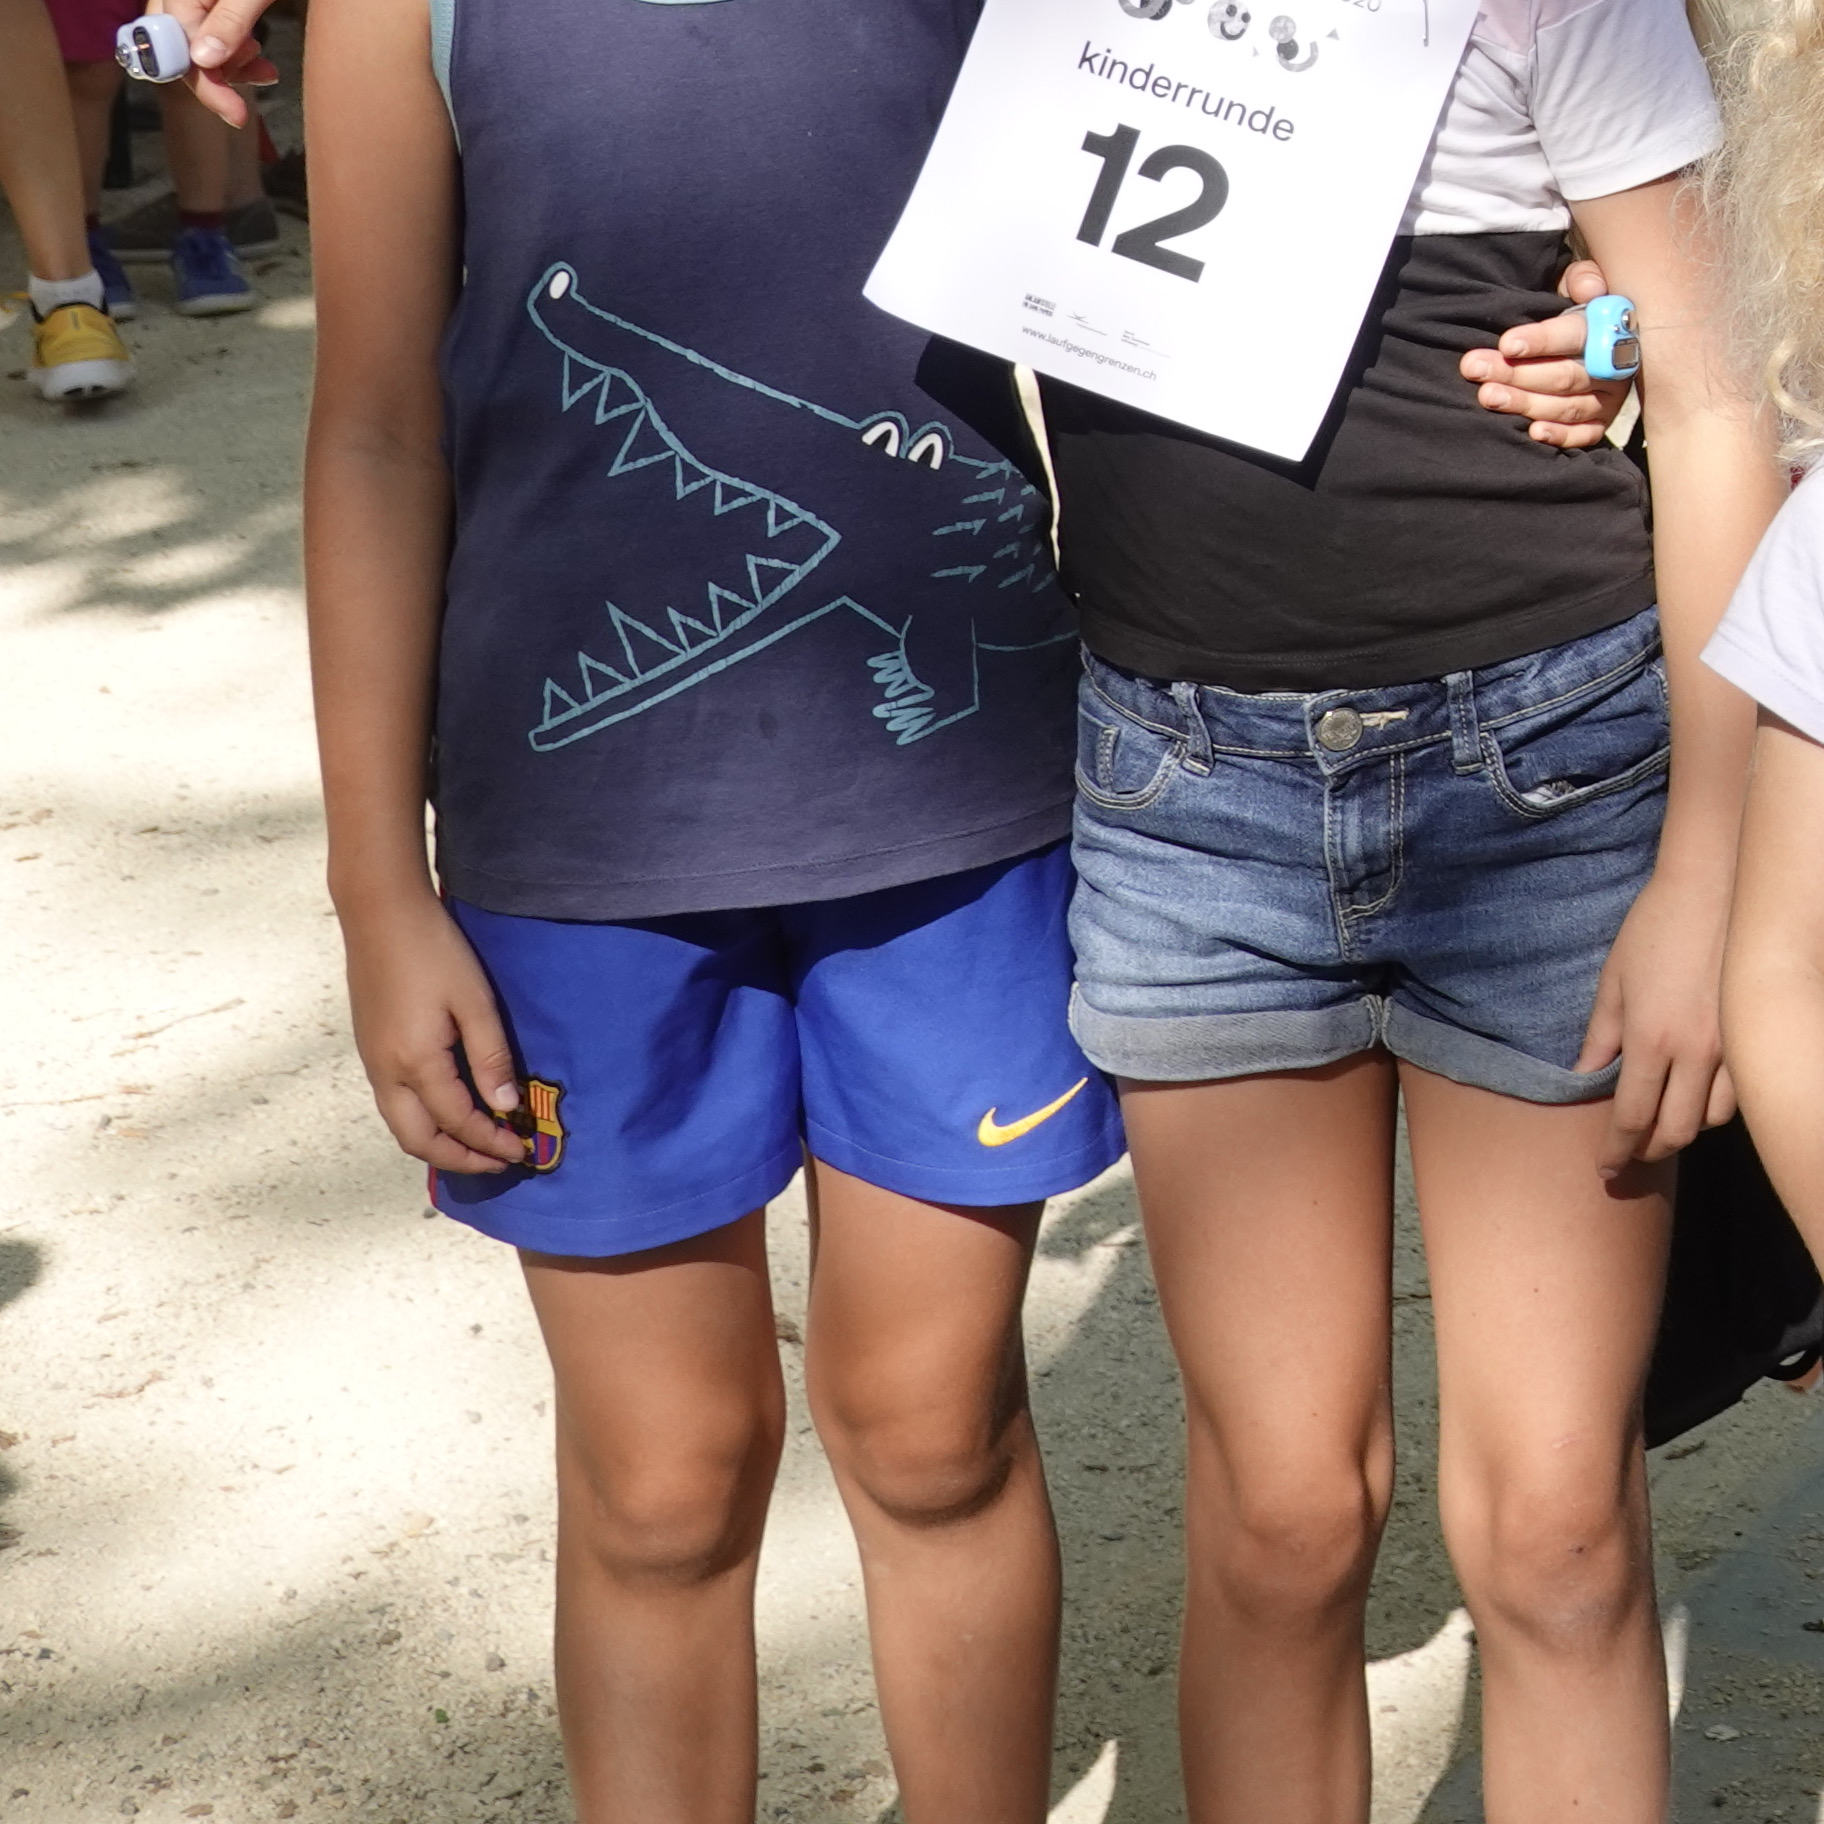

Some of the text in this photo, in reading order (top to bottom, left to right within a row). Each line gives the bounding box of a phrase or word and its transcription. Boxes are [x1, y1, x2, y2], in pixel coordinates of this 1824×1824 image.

[1077, 41, 1297, 142] kinderrunde
[1076, 123, 1230, 283] 12
[1022, 326, 1157, 381] www.laufgegengrenzen.ch
